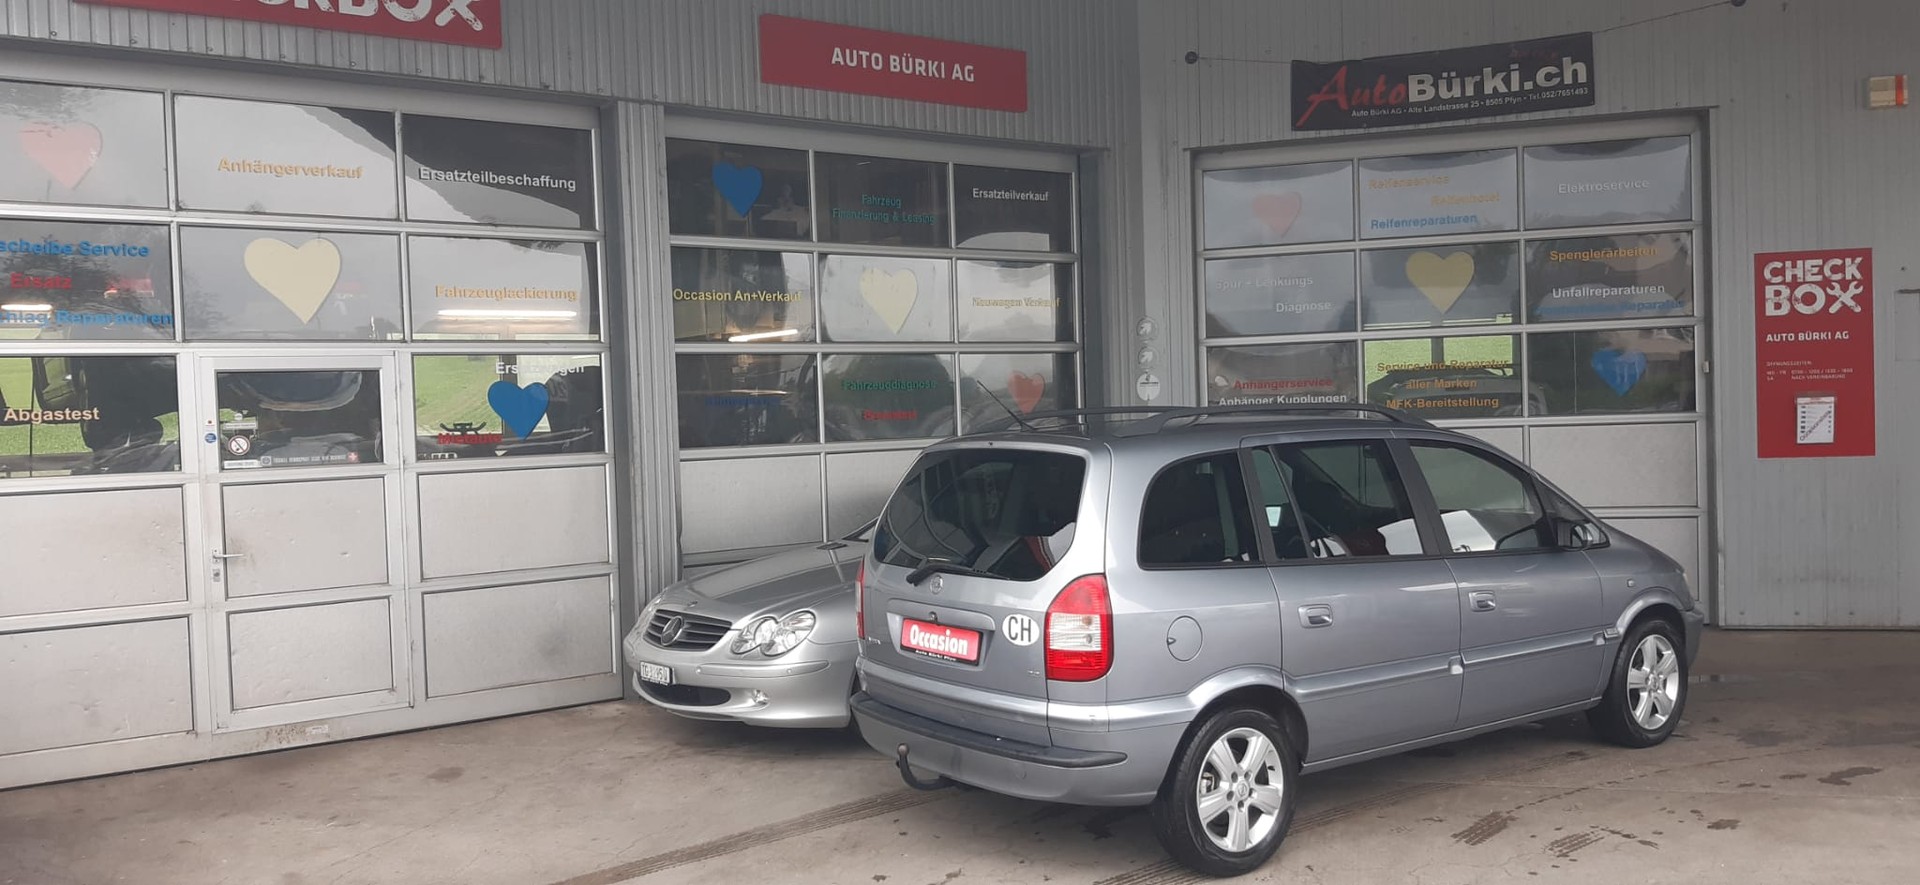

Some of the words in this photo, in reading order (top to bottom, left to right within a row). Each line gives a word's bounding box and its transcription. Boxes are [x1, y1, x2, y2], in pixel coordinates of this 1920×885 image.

[831, 47, 883, 70] AUTO
[890, 53, 945, 79] BÜRKI
[952, 63, 974, 82] AG
[1352, 109, 1369, 117] Auto
[1424, 101, 1469, 112] Landstrasse
[1471, 100, 1479, 108] 25
[218, 157, 365, 179] Anhängerverkauf
[419, 166, 576, 192] Ersatzteilbeschaffung
[1558, 178, 1650, 194] Elektroservice
[862, 194, 901, 209] Fahrzeug
[972, 187, 1049, 201] Ersatzteilverkauf
[832, 208, 890, 224] Finanzierung
[1371, 214, 1479, 230] Reifenreparaturen
[79, 241, 149, 258] Service
[1550, 247, 1658, 262] Spenglerarbeiten
[1764, 257, 1863, 283] CHECK
[10, 272, 72, 289] Ersatz
[435, 284, 578, 303] Fahrzeuglackierung
[673, 288, 731, 301] Occasion
[734, 289, 802, 302] An+Verkauf
[1552, 285, 1665, 299] Unfallreparaturen
[1765, 281, 1863, 316] BOX
[1276, 301, 1332, 314] Diagnose
[55, 310, 173, 326] Reparaturen
[1766, 333, 1794, 342] AUTO
[1798, 331, 1831, 341] BÜRKI
[1835, 331, 1849, 339] AG
[1377, 361, 1421, 373] Service
[1423, 360, 1446, 371] und
[1450, 358, 1510, 372] Reparatur
[1405, 379, 1432, 389] aller
[1434, 378, 1477, 389] Marken
[1386, 396, 1500, 410] MFK-Bereitstellung
[4, 407, 100, 425] Abgastest
[1008, 616, 1032, 643] CH
[910, 624, 968, 656] Occasion
